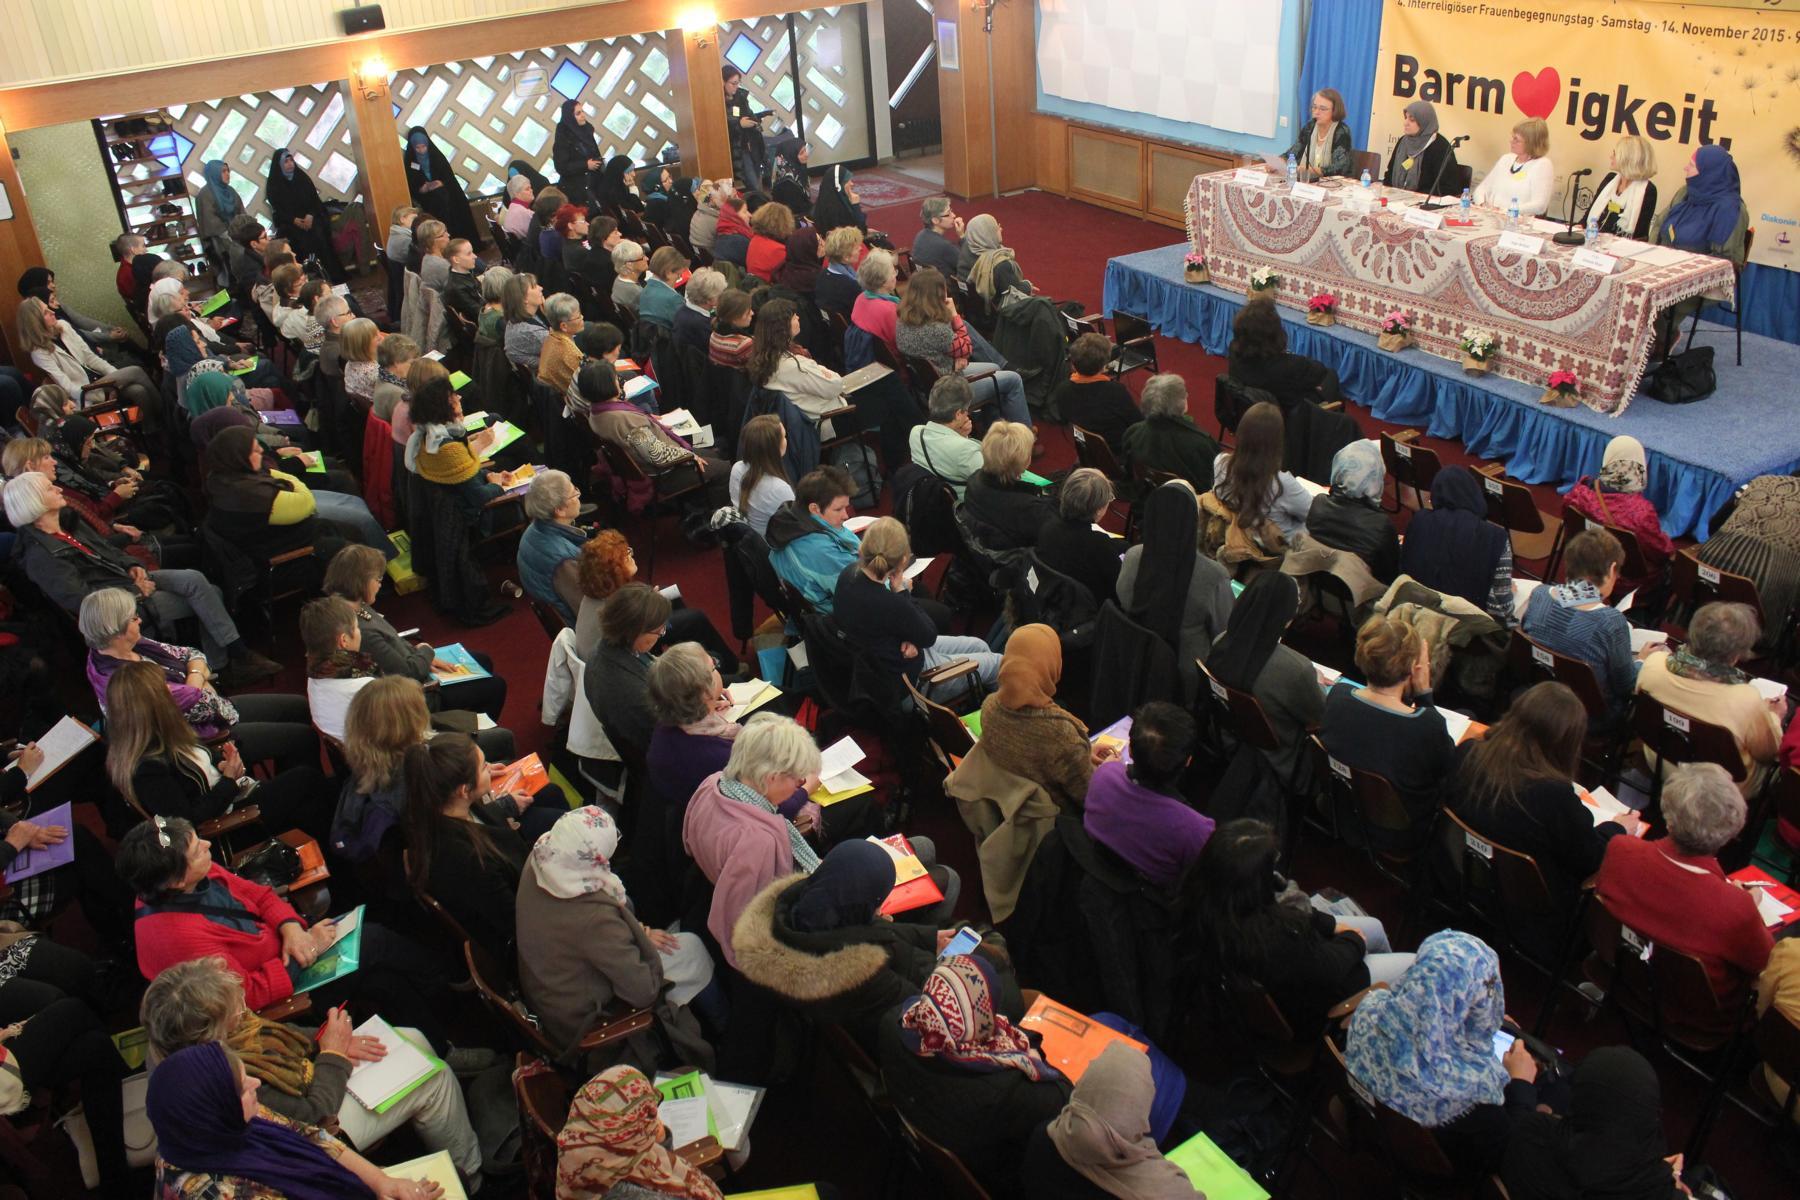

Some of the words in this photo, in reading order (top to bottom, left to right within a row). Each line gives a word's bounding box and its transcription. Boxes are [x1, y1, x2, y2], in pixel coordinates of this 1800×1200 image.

[1407, 0, 1476, 14] Interreligiöser
[1479, 4, 1594, 28] Frauenbegegnungstag
[1601, 15, 1651, 33] Samstag
[1662, 20, 1679, 33] 14.
[1682, 22, 1749, 40] November
[1751, 27, 1786, 42] 2015
[1393, 53, 1506, 115] Barm
